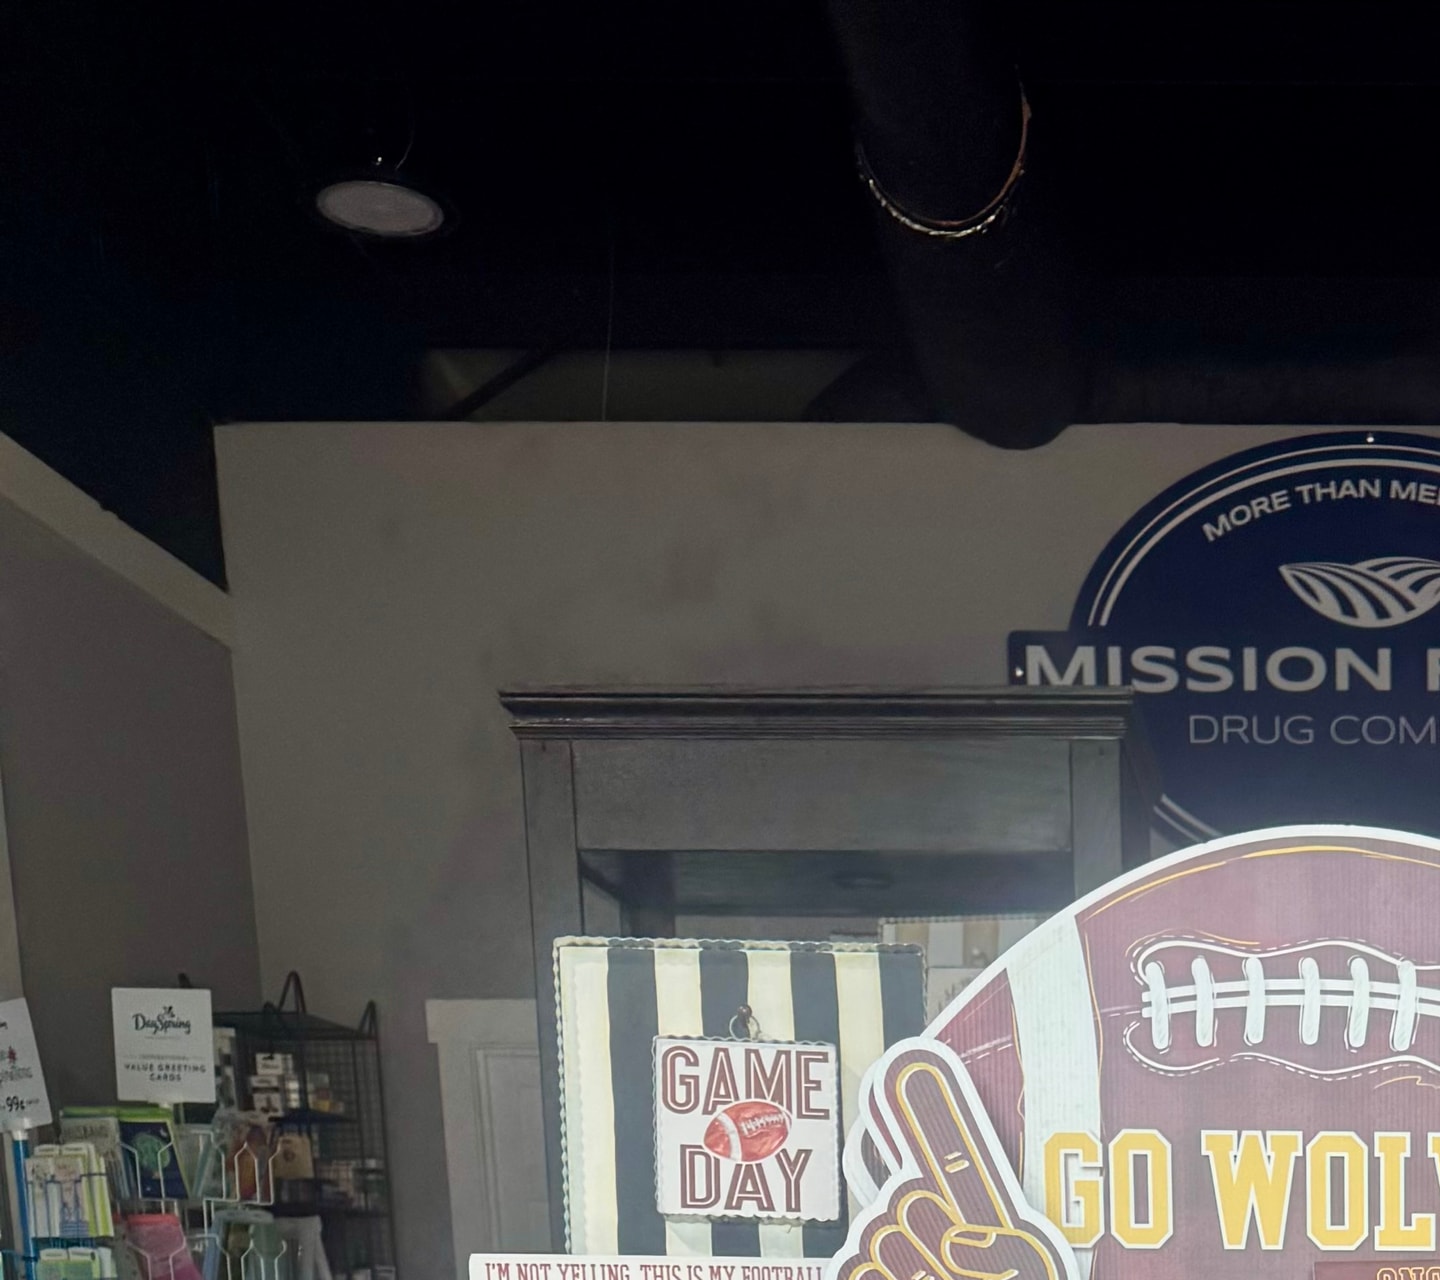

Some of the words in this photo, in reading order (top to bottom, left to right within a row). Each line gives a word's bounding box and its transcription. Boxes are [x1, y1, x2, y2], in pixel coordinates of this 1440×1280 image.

[1202, 490, 1290, 543] MORE
[1294, 478, 1382, 502] THAN
[1024, 645, 1394, 694] MISSION
[1188, 714, 1315, 745] DRUG
[661, 1045, 830, 1121] GAME
[680, 1144, 812, 1213] DAY
[1043, 1129, 1173, 1250] GO
